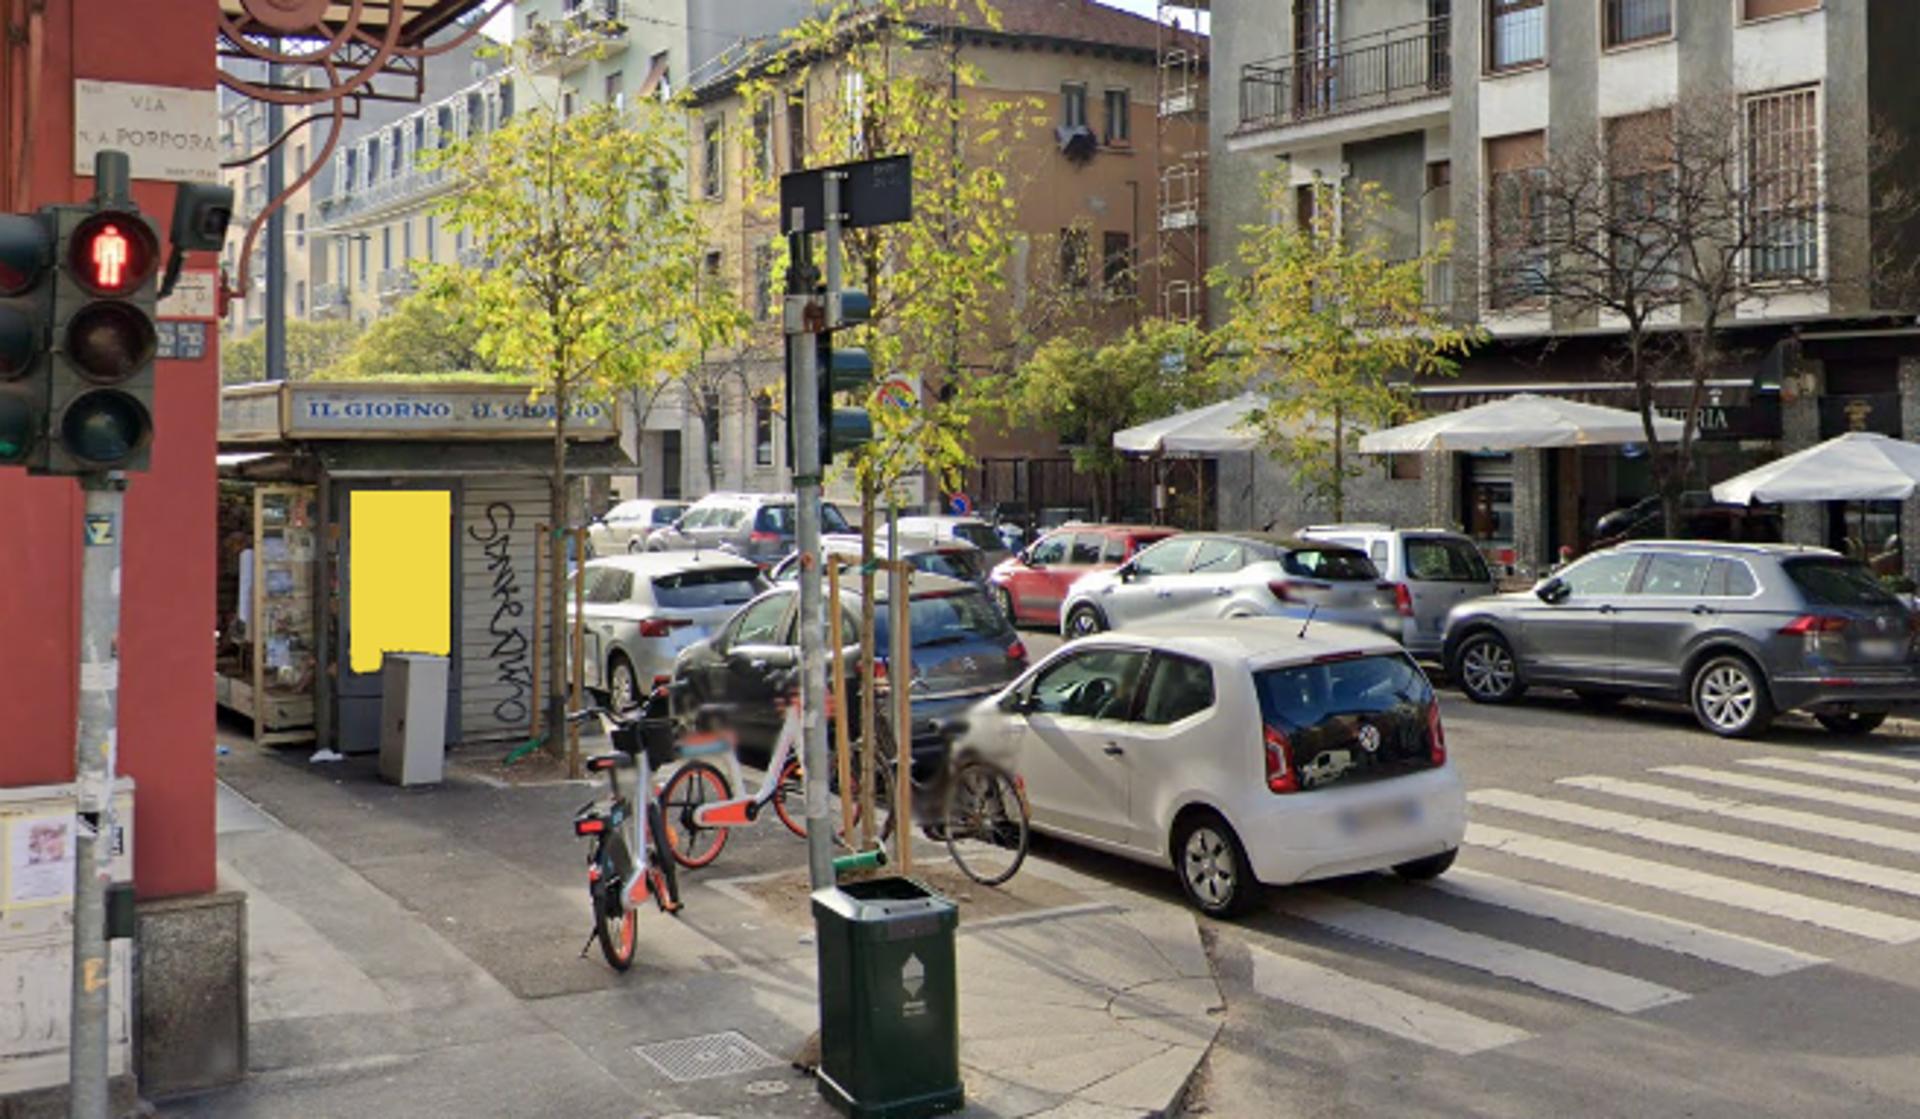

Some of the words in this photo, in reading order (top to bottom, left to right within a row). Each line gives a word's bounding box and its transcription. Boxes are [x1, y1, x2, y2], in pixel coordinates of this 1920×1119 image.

[131, 96, 167, 112] VIA
[116, 128, 217, 152] PORPORA
[309, 402, 339, 418] IL
[344, 402, 450, 417] GIORNO
